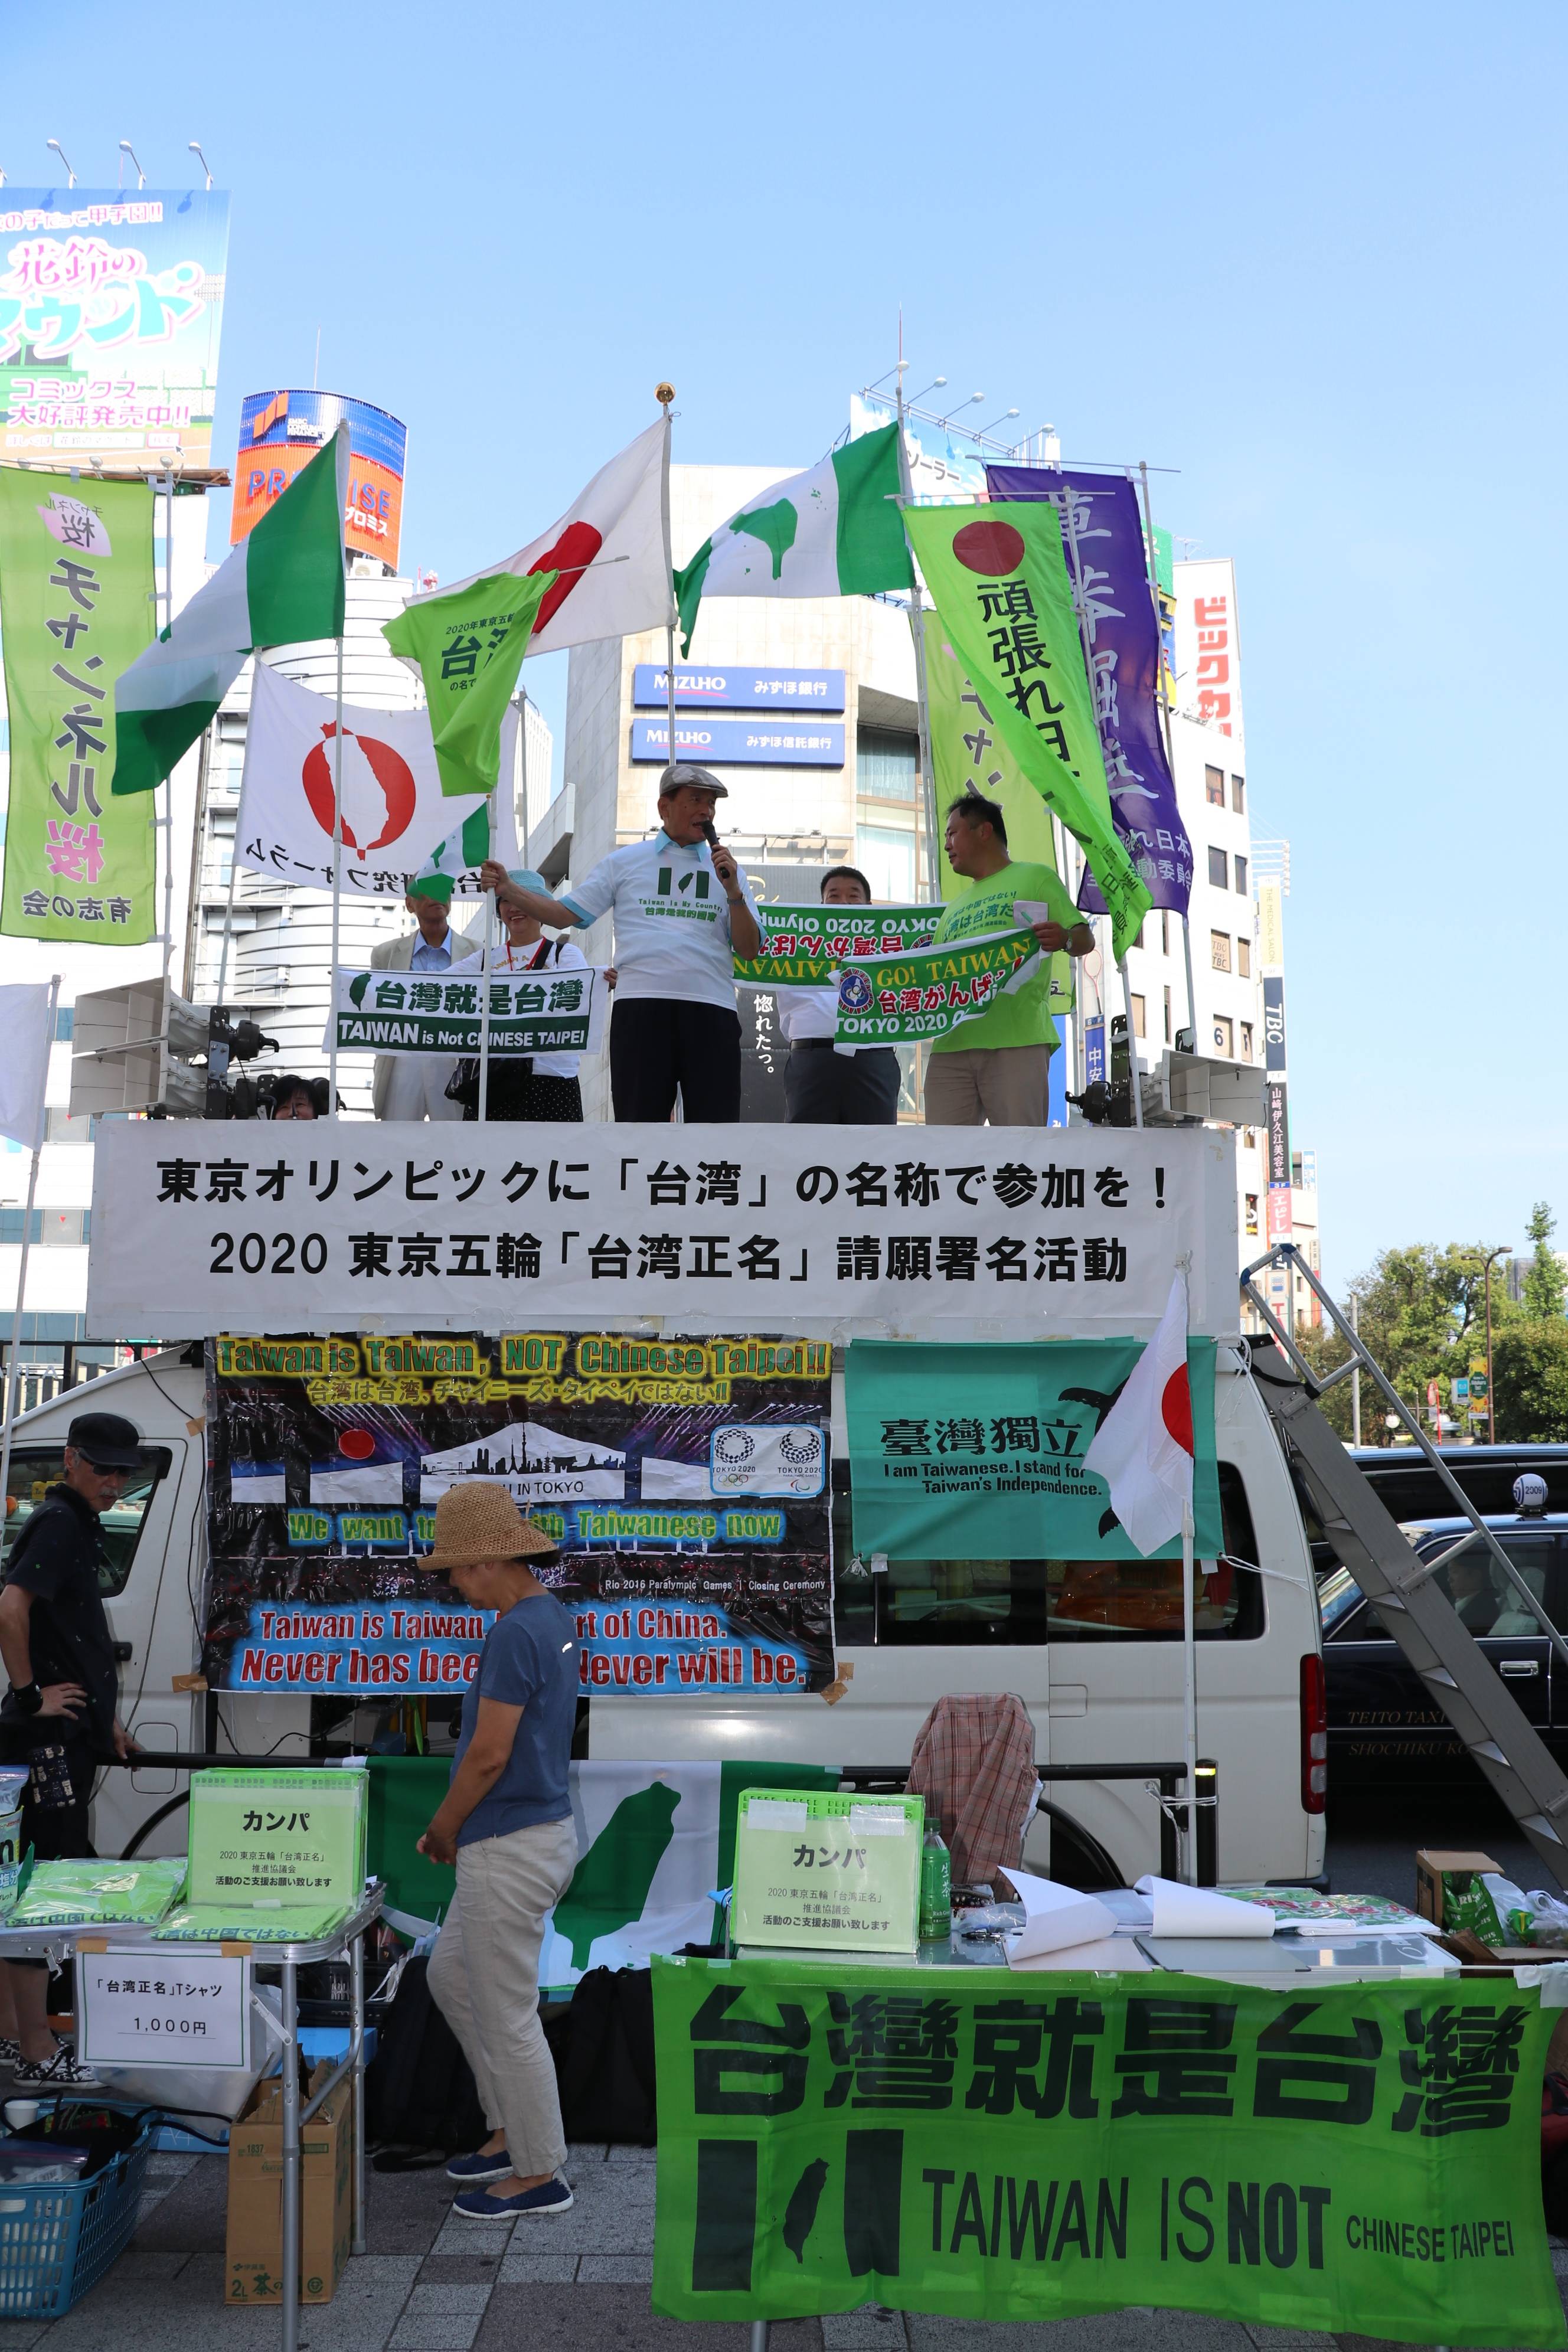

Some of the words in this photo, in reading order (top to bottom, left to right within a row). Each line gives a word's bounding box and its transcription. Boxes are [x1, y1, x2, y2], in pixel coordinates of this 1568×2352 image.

[0, 205, 162, 230] の子だって甲子園!!
[14, 241, 136, 286] 花鈴の
[12, 380, 136, 400] コミックス
[9, 405, 190, 426] 大好評発売中!!
[249, 468, 391, 518] PRISE
[1194, 596, 1232, 737] ビックカ
[654, 674, 727, 690] MIZUHO
[754, 680, 828, 696] みずほ銀行
[746, 735, 832, 750] みずほ信託銀行
[638, 898, 665, 906] Taiwan
[826, 917, 876, 934] 2020
[876, 965, 917, 988] GO!
[926, 937, 1033, 982] TAIWAN
[1212, 956, 1227, 968] TBC
[374, 978, 584, 1016] 台灣就是台灣
[338, 1020, 419, 1044] TAIWAN
[422, 1030, 435, 1045] is
[437, 1030, 463, 1046] Not
[537, 1029, 586, 1046] TAIPEI
[753, 993, 775, 1074] 惚れたっ。
[835, 1017, 900, 1034] TOKYO
[904, 1012, 948, 1033] 2020
[1266, 1002, 1284, 1044] TBC
[1273, 1195, 1288, 1232] エピレ
[209, 1231, 328, 1274] 2020
[221, 1340, 323, 1373] Taiwan
[328, 1340, 355, 1373] is
[505, 1337, 562, 1371] NOT
[580, 1338, 704, 1374] Chinese
[880, 1415, 1086, 1459] 臺灣獨立
[713, 1465, 737, 1474] TOKYO
[892, 1464, 918, 1478] am
[920, 1462, 1013, 1478] Taiwanese.
[1024, 1460, 1061, 1478] stand
[1065, 1463, 1086, 1479] for
[518, 1483, 531, 1495] IN
[534, 1481, 584, 1494] TOKYO
[922, 1476, 992, 1495] Taiwan's
[996, 1477, 1103, 1497] Independence.
[289, 1513, 329, 1540] We
[342, 1514, 404, 1541] want
[579, 1511, 716, 1539] Taiwanese
[727, 1513, 780, 1538] now
[605, 1579, 620, 1590] Rio
[623, 1579, 646, 1590] 2016
[649, 1579, 697, 1591] Paralympic
[703, 1580, 733, 1590] Games
[749, 1580, 780, 1592] Closing
[783, 1580, 826, 1591] Ceremony
[260, 1611, 354, 1640] Taiwan
[361, 1610, 384, 1639] is
[603, 1608, 632, 1638] of
[638, 1608, 727, 1639] China.
[240, 1648, 344, 1683] Never
[348, 1648, 411, 1684] has
[678, 1647, 742, 1685] will
[752, 1647, 806, 1685] be.
[1348, 1710, 1402, 1724] TEITO
[1405, 1710, 1446, 1724] TAXI
[1348, 1742, 1442, 1756] SHOCHIKU
[243, 1810, 311, 1832] カンパ
[220, 1851, 239, 1861] 2020
[240, 1850, 326, 1862] 東京五輪「台湾正名」
[793, 1844, 867, 1870] カンパ
[251, 1863, 296, 1874] 推進協議会
[215, 1876, 332, 1888] 活動のご支援お願い致します
[940, 1862, 951, 1898] 生茶
[767, 1887, 788, 1897] 2020
[802, 1903, 851, 1915] 推進協議会
[763, 1915, 891, 1932] 活動のご支援お願い致します
[133, 2017, 207, 2036] 1,000円
[690, 1985, 1531, 2137] 台灣就是台灣
[247, 2144, 264, 2154] 1837
[922, 2168, 1129, 2261] TAIWAN
[1161, 2175, 1216, 2262] IS
[1227, 2181, 1331, 2271] NOT
[1345, 2214, 1445, 2263] CHINESE
[1450, 2219, 1515, 2260] TAIPEI
[231, 2279, 249, 2297] 2L
